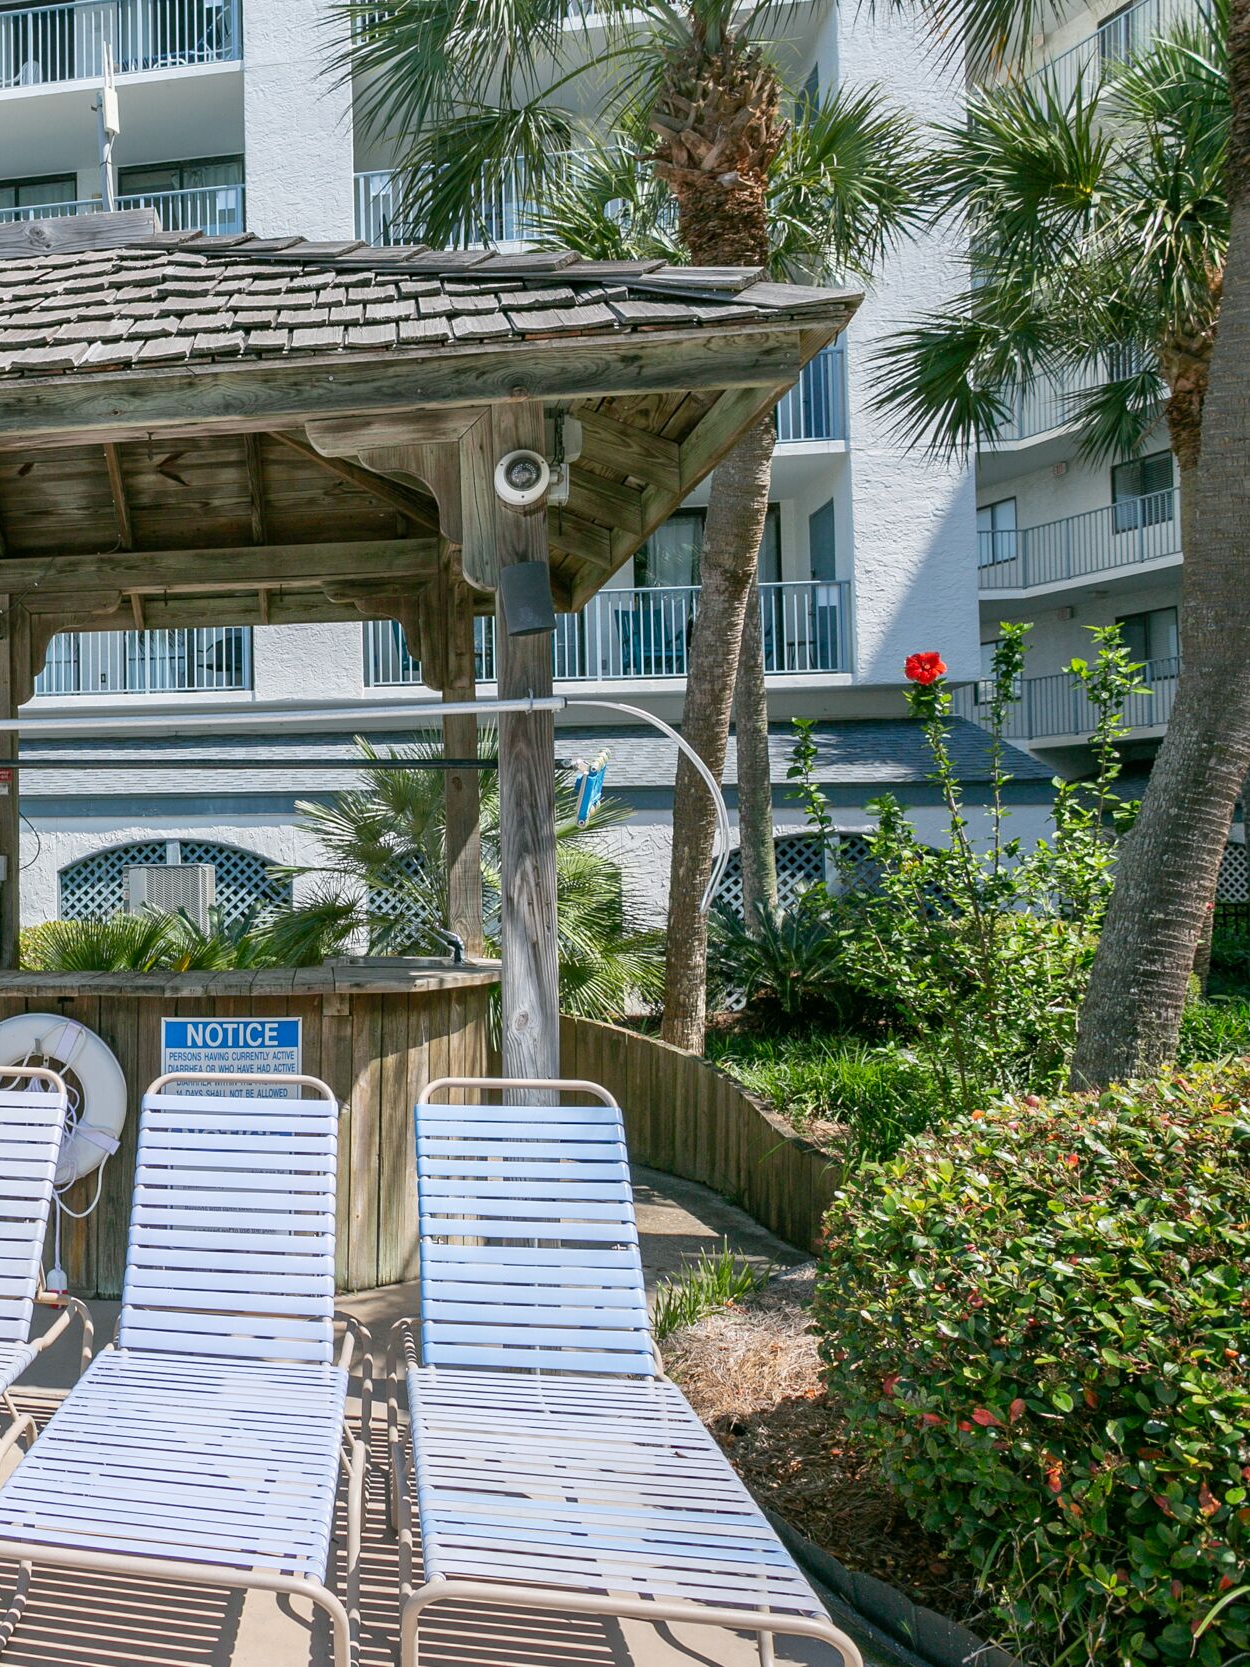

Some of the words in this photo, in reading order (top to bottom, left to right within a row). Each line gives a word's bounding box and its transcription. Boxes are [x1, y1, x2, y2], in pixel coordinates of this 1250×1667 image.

[187, 1023, 278, 1047] NOTICE
[169, 1052, 201, 1061] PERSONS
[204, 1052, 229, 1061] HAVING
[232, 1051, 270, 1061] CURRENTLY
[272, 1051, 294, 1060] ACTIVE
[168, 1064, 203, 1073] DIARRHEA
[206, 1064, 215, 1073] OR
[218, 1064, 234, 1073] WHO
[237, 1064, 254, 1073] HAVE
[257, 1064, 270, 1073] HAD
[273, 1063, 295, 1072] ACTIVE
[230, 1089, 243, 1098] NOT
[246, 1089, 254, 1098] BE
[258, 1088, 288, 1098] ALLOWED
